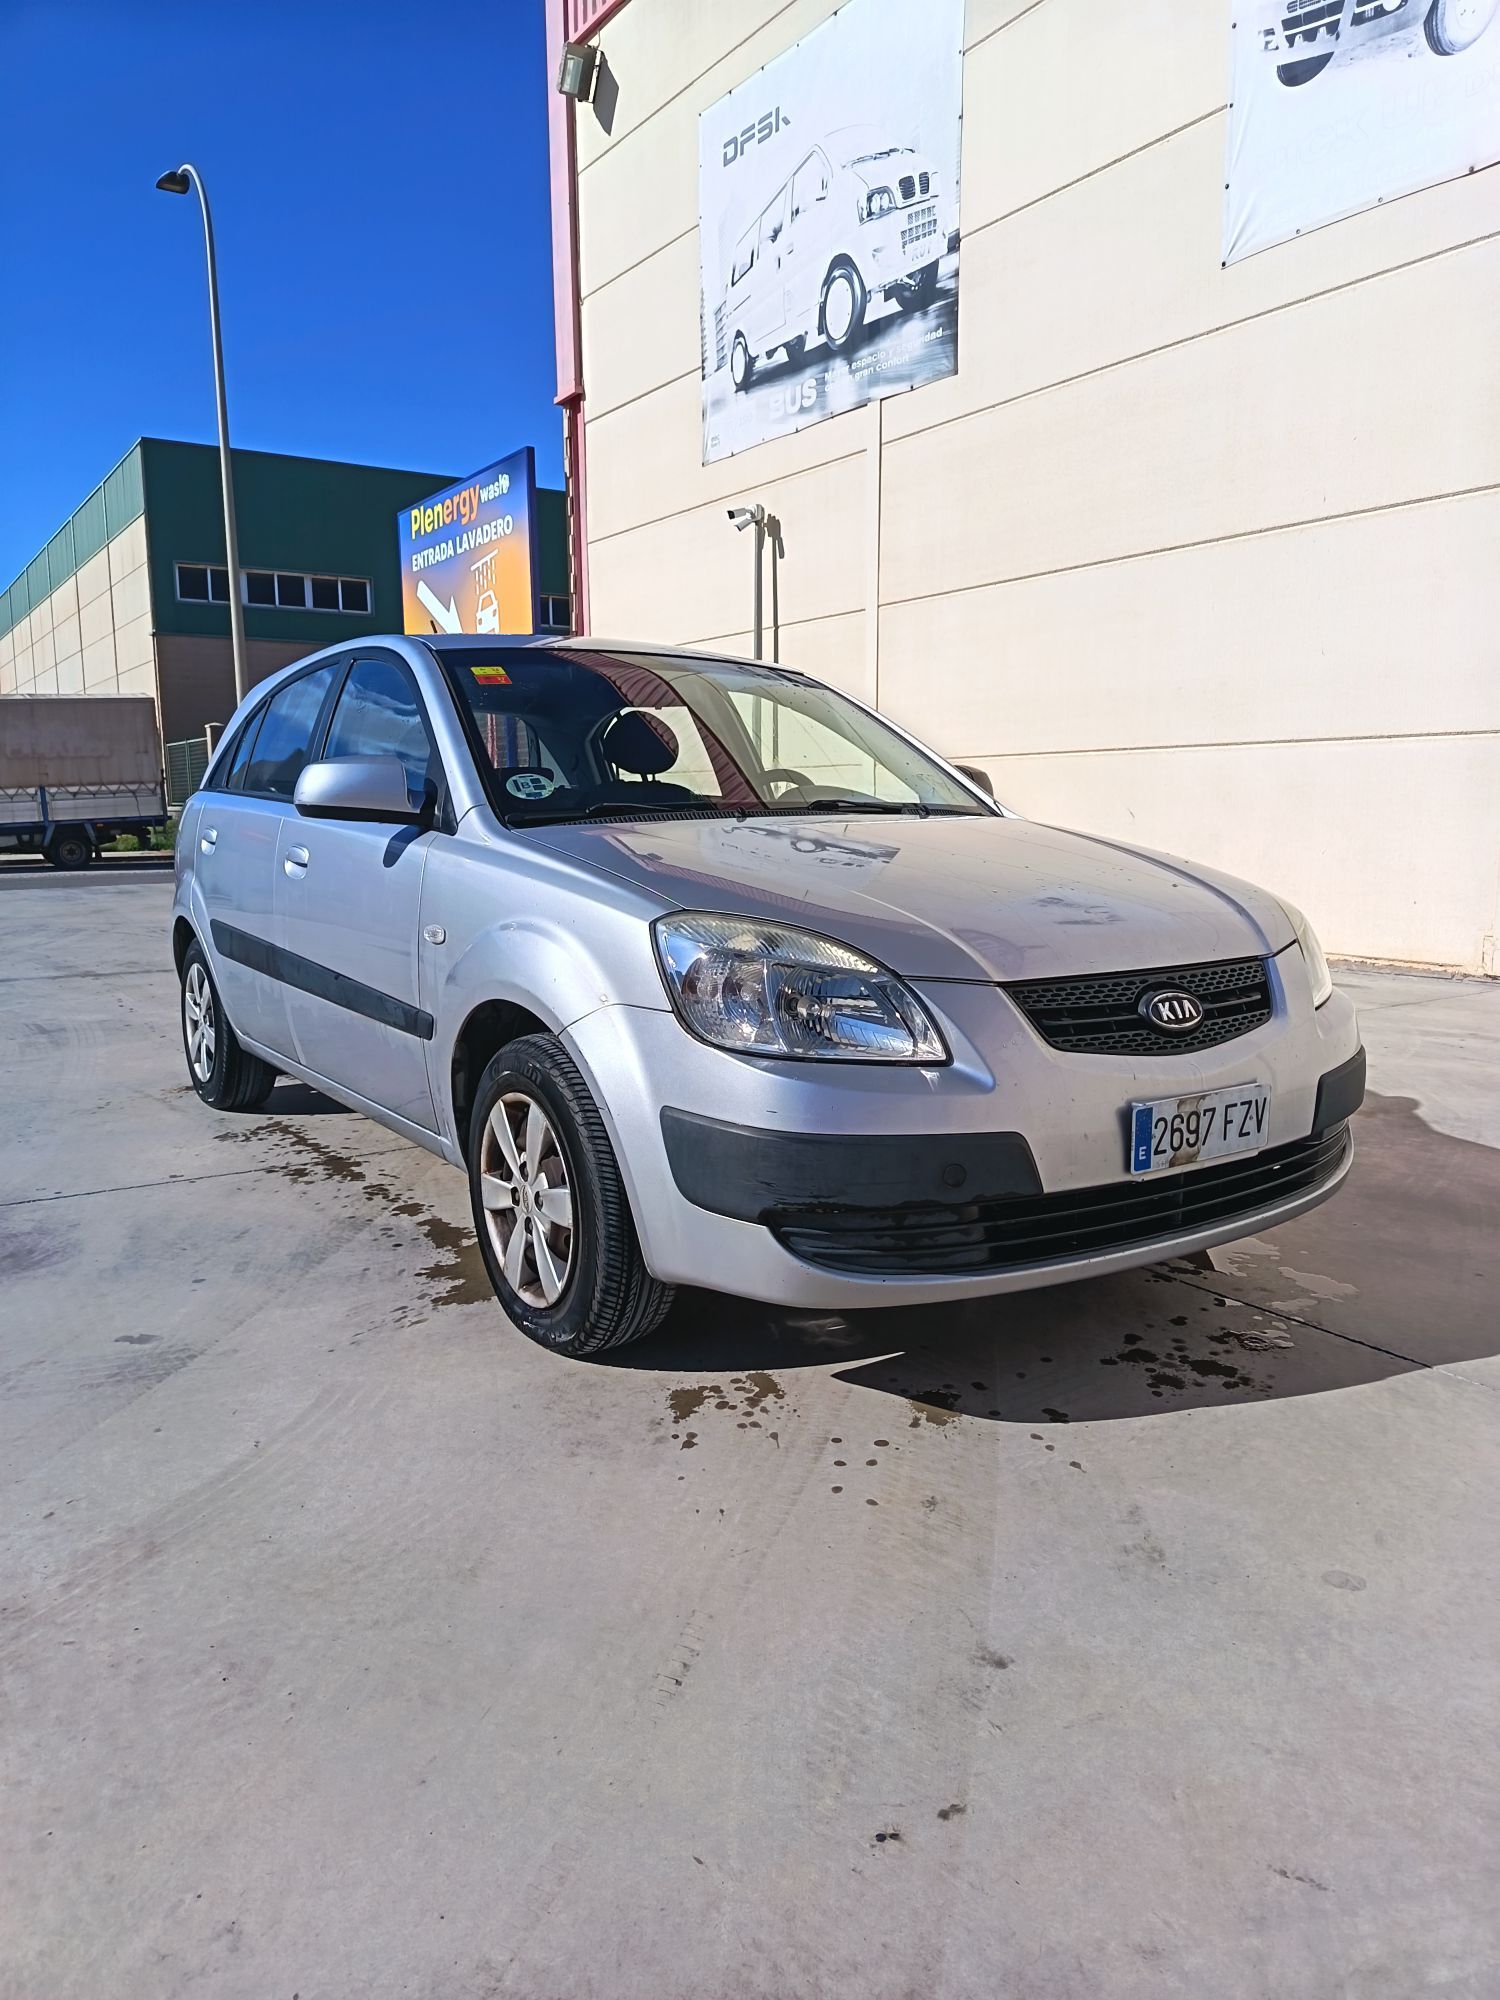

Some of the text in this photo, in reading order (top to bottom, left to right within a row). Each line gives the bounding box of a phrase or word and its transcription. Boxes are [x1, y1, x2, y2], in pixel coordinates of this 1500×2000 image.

[851, 350, 886, 370] espacio
[854, 354, 910, 382] gran confort
[768, 378, 818, 421] BUS
[410, 483, 480, 540] Plenergy
[411, 514, 514, 573] ENTRADA LAVADERO
[1156, 999, 1198, 1022] KIA
[1138, 1097, 1268, 1161] E 2697 FZV
